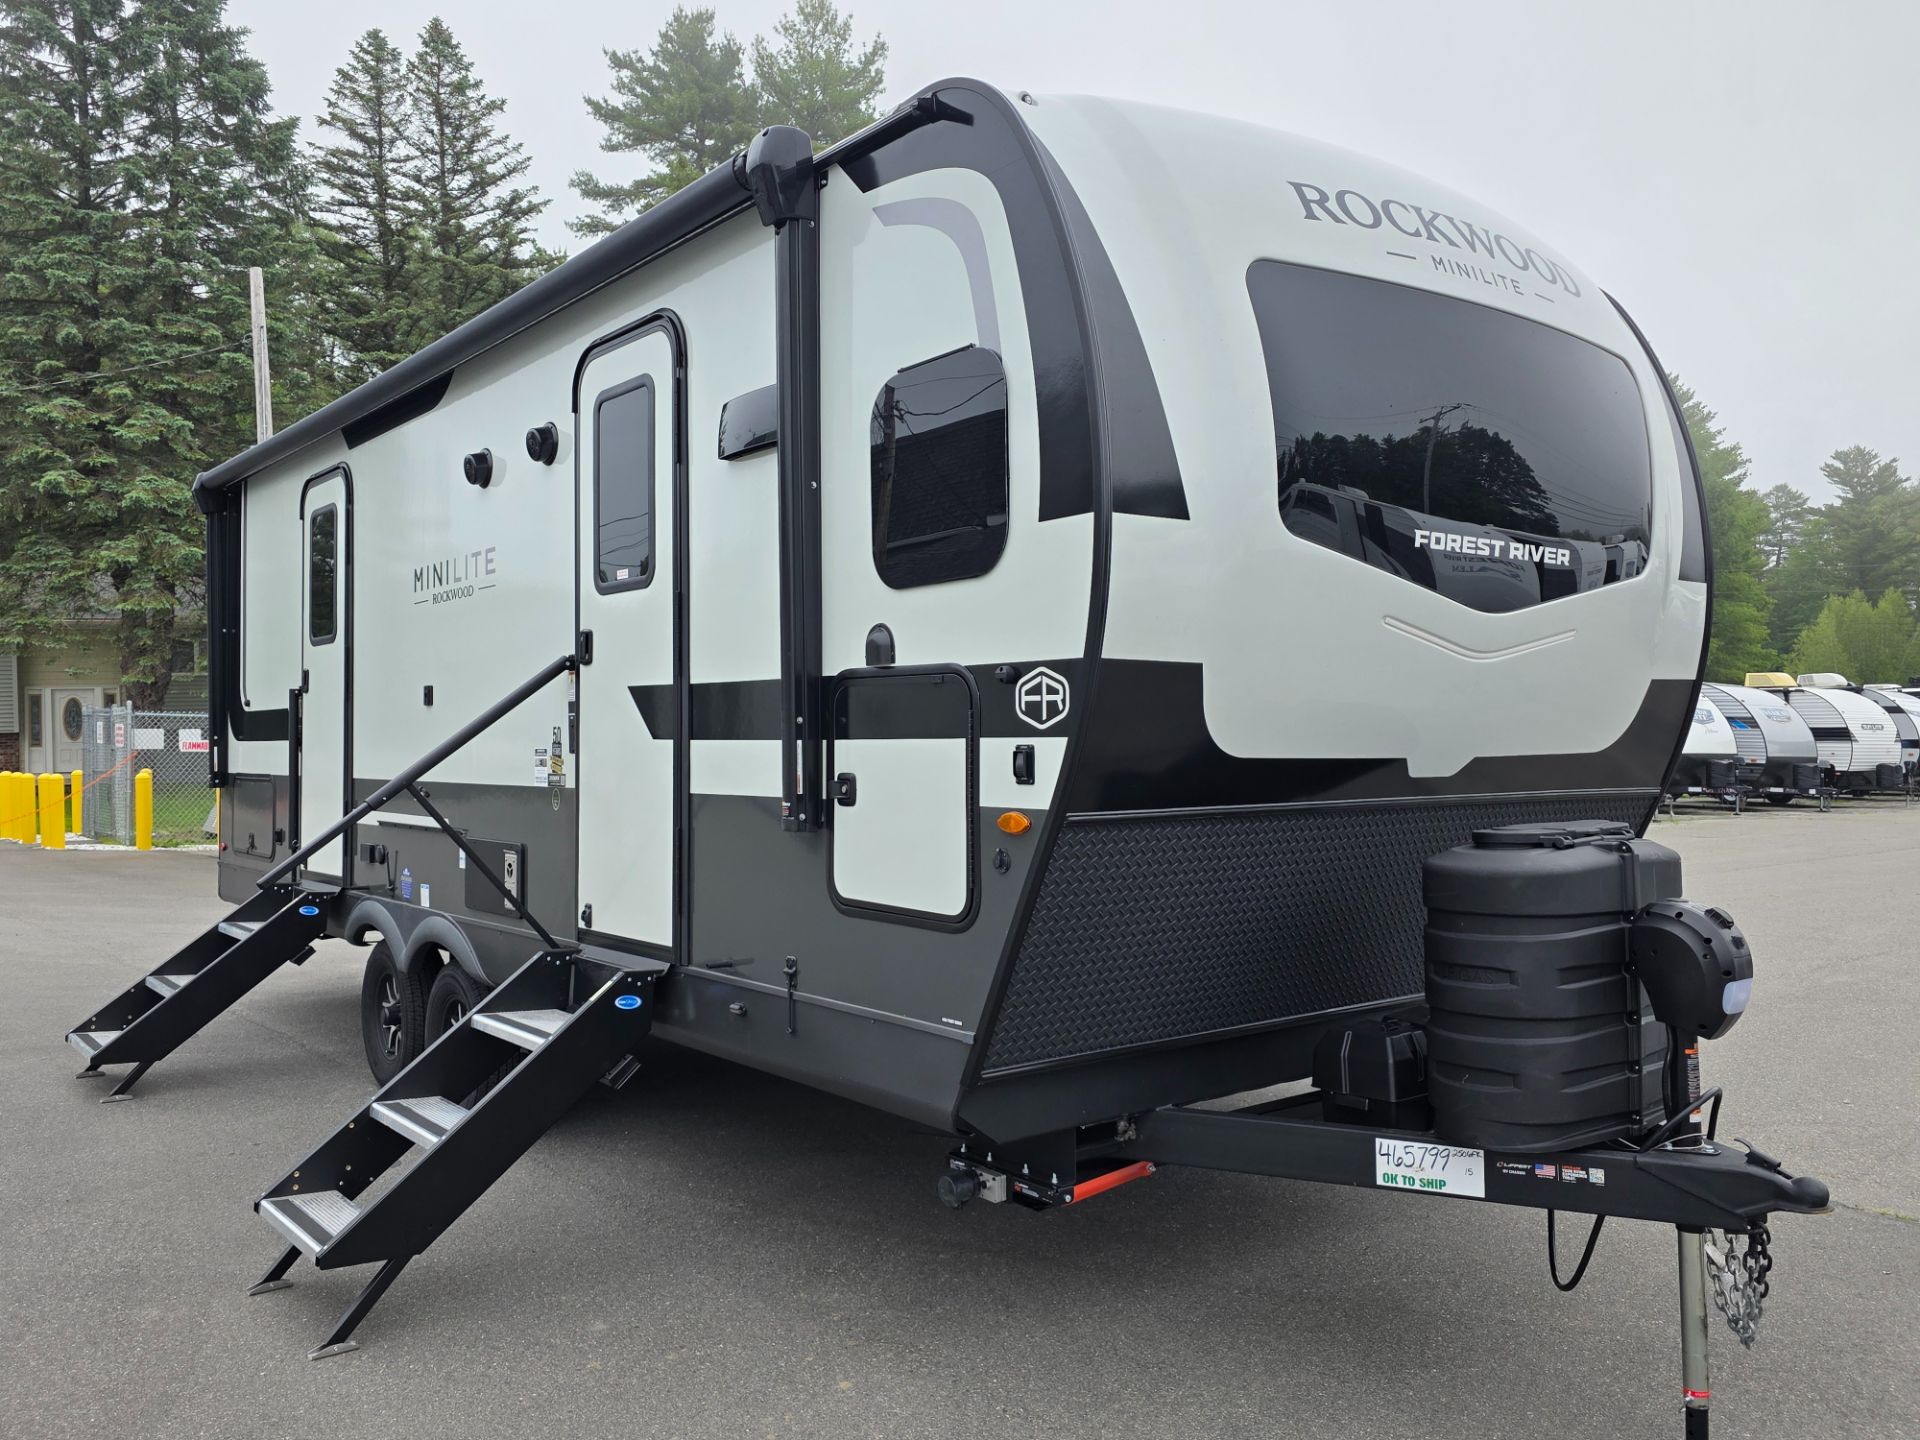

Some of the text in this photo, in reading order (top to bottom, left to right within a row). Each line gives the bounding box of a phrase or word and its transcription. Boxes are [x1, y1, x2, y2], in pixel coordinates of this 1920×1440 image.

[1286, 180, 1581, 297] ROCKWOOD
[1432, 255, 1524, 295] MINILITE
[1414, 529, 1570, 566] FOREST RIVER
[414, 546, 496, 592] MINILITE
[432, 584, 474, 604] ROCKWOOD
[182, 742, 208, 751] FLAMMAB
[1379, 1141, 1451, 1171] 465799
[1382, 1172, 1447, 1190] OK TO SHIP
[1464, 1168, 1474, 1176] 15
